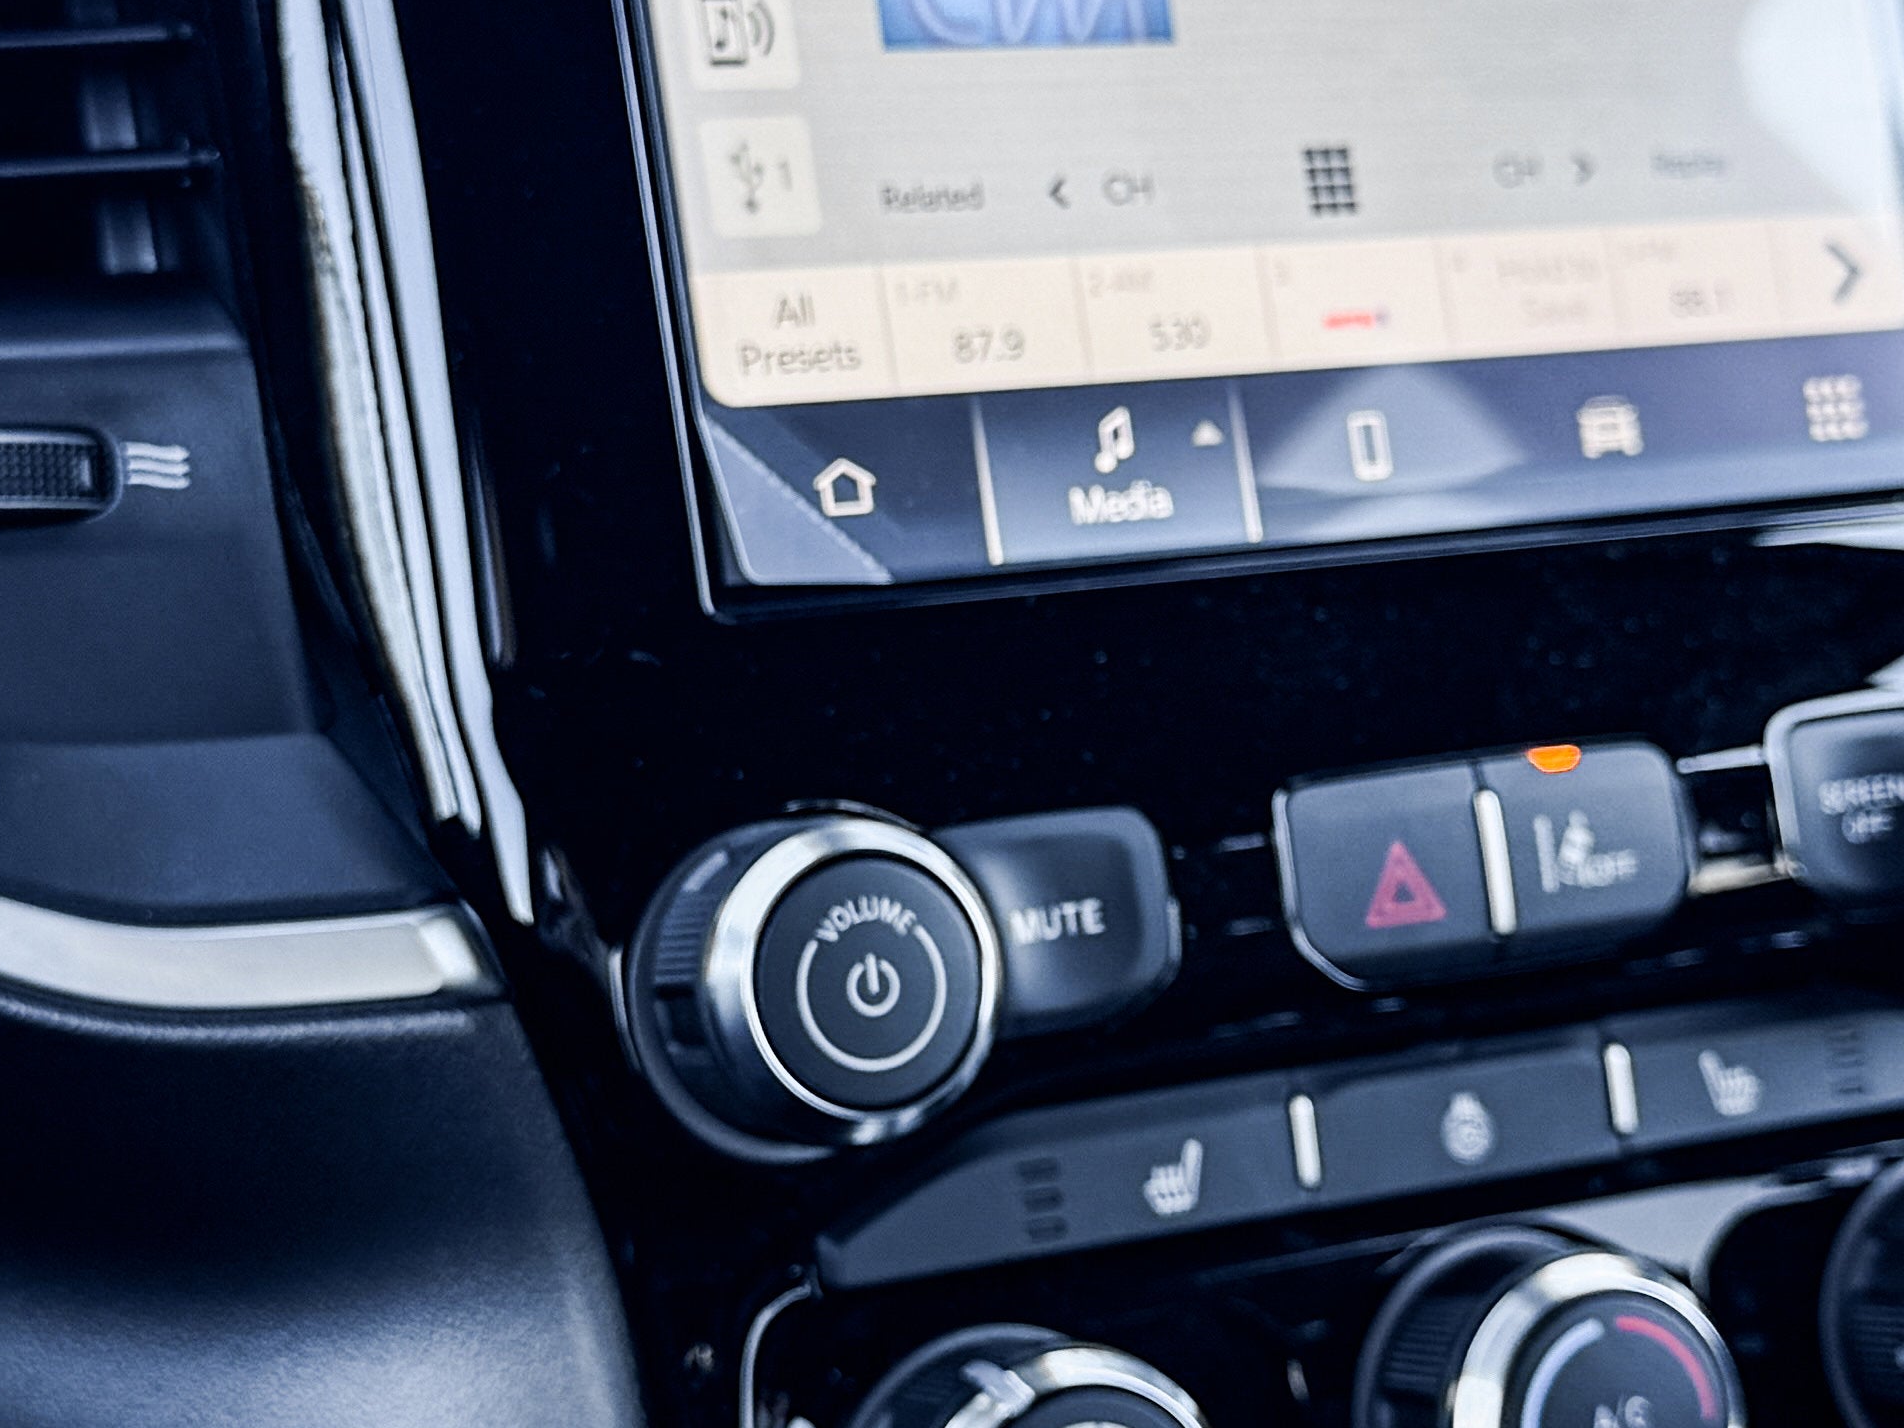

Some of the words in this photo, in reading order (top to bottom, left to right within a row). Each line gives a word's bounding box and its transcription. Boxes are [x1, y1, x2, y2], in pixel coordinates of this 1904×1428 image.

[773, 292, 816, 326] All
[952, 332, 1026, 364] 87.9
[1148, 316, 1212, 352] 530
[739, 341, 861, 376] Presets
[1069, 480, 1174, 525] Media
[813, 894, 918, 944] VOLUME
[1008, 898, 1106, 946] MUTE
